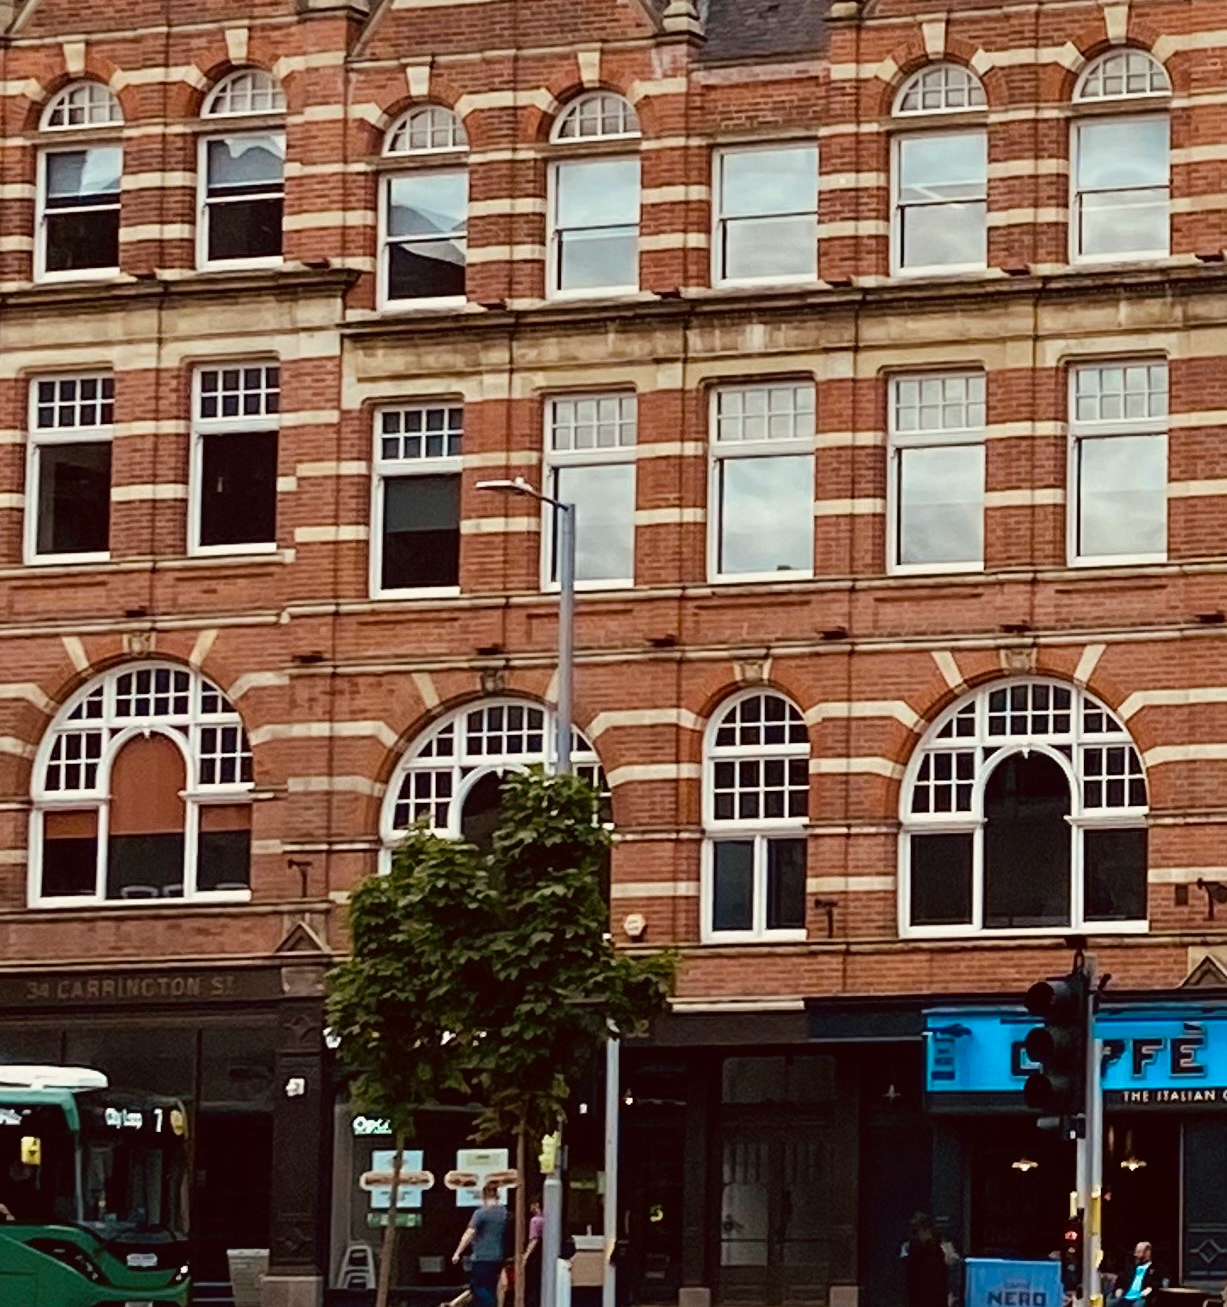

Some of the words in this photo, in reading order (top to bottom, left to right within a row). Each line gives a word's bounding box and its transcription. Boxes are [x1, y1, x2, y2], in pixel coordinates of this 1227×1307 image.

[56, 977, 201, 999] CARRINGTON
[1011, 1022, 1205, 1078] CFFÈ
[1124, 1089, 1150, 1103] THE
[1156, 1088, 1217, 1103] ITALIAN
[987, 1291, 1047, 1307] NERO
